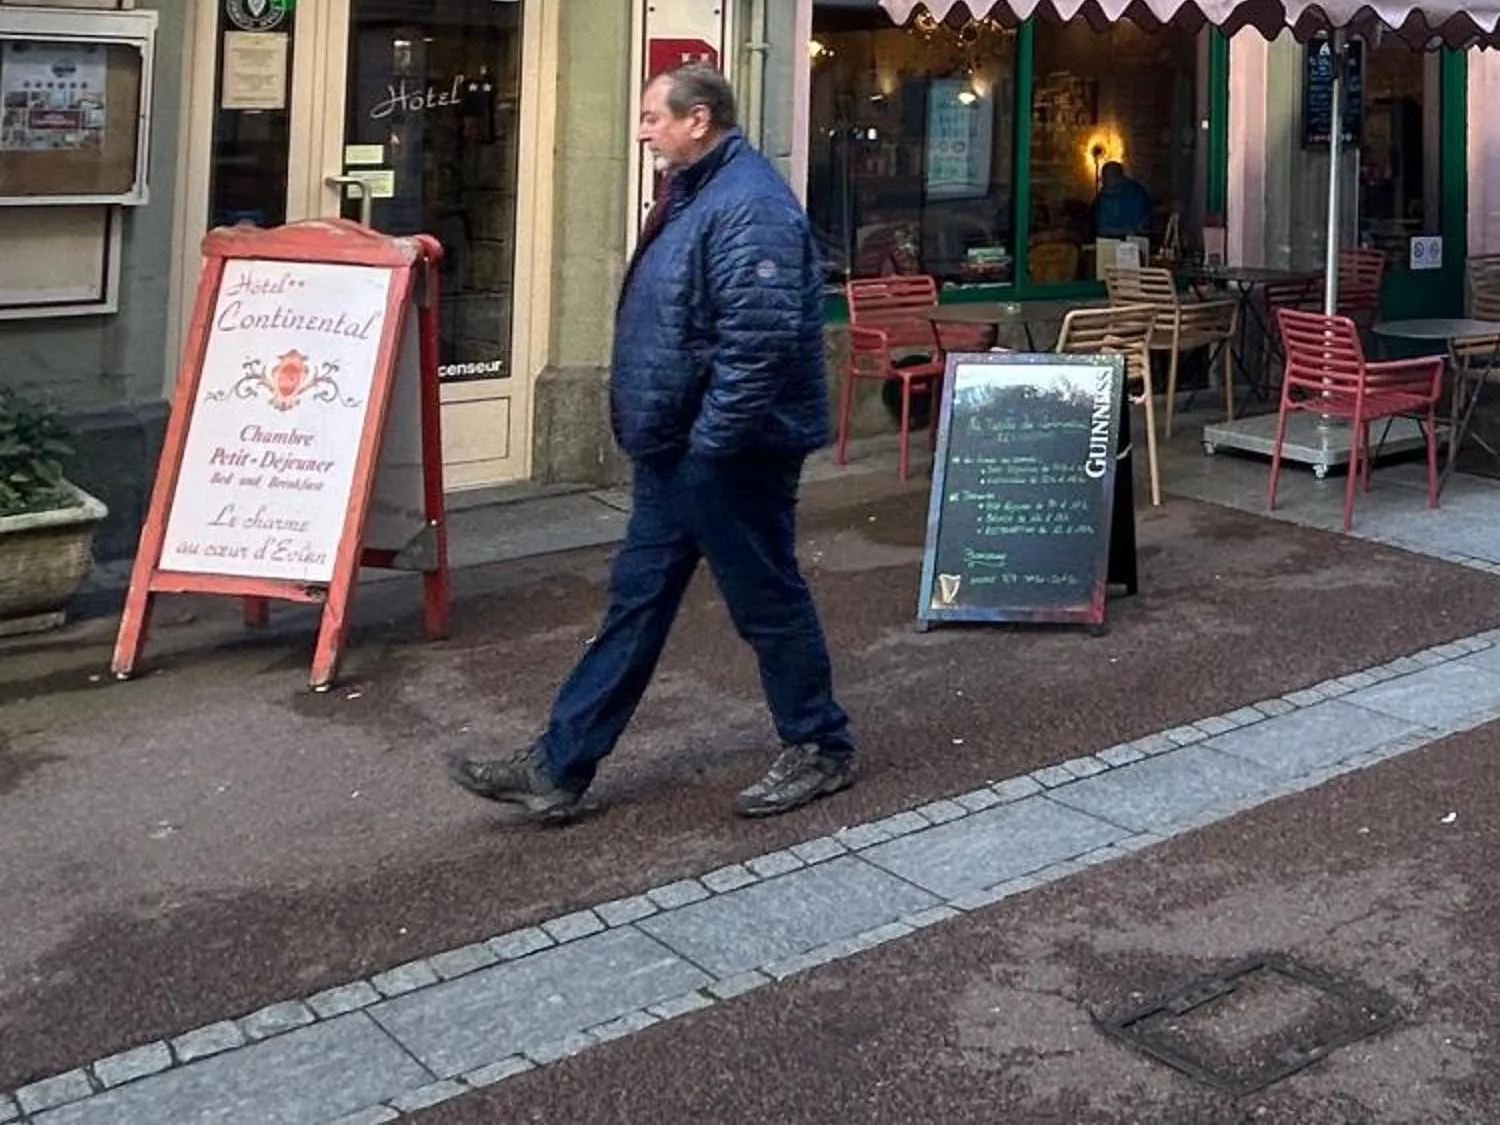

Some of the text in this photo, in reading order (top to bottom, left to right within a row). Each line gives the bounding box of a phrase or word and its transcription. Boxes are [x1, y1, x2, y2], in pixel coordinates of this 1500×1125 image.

[217, 300, 381, 340] Continental
[437, 360, 503, 377] censeur
[239, 424, 315, 446] Chambre
[1085, 368, 1113, 478] GUINNESS
